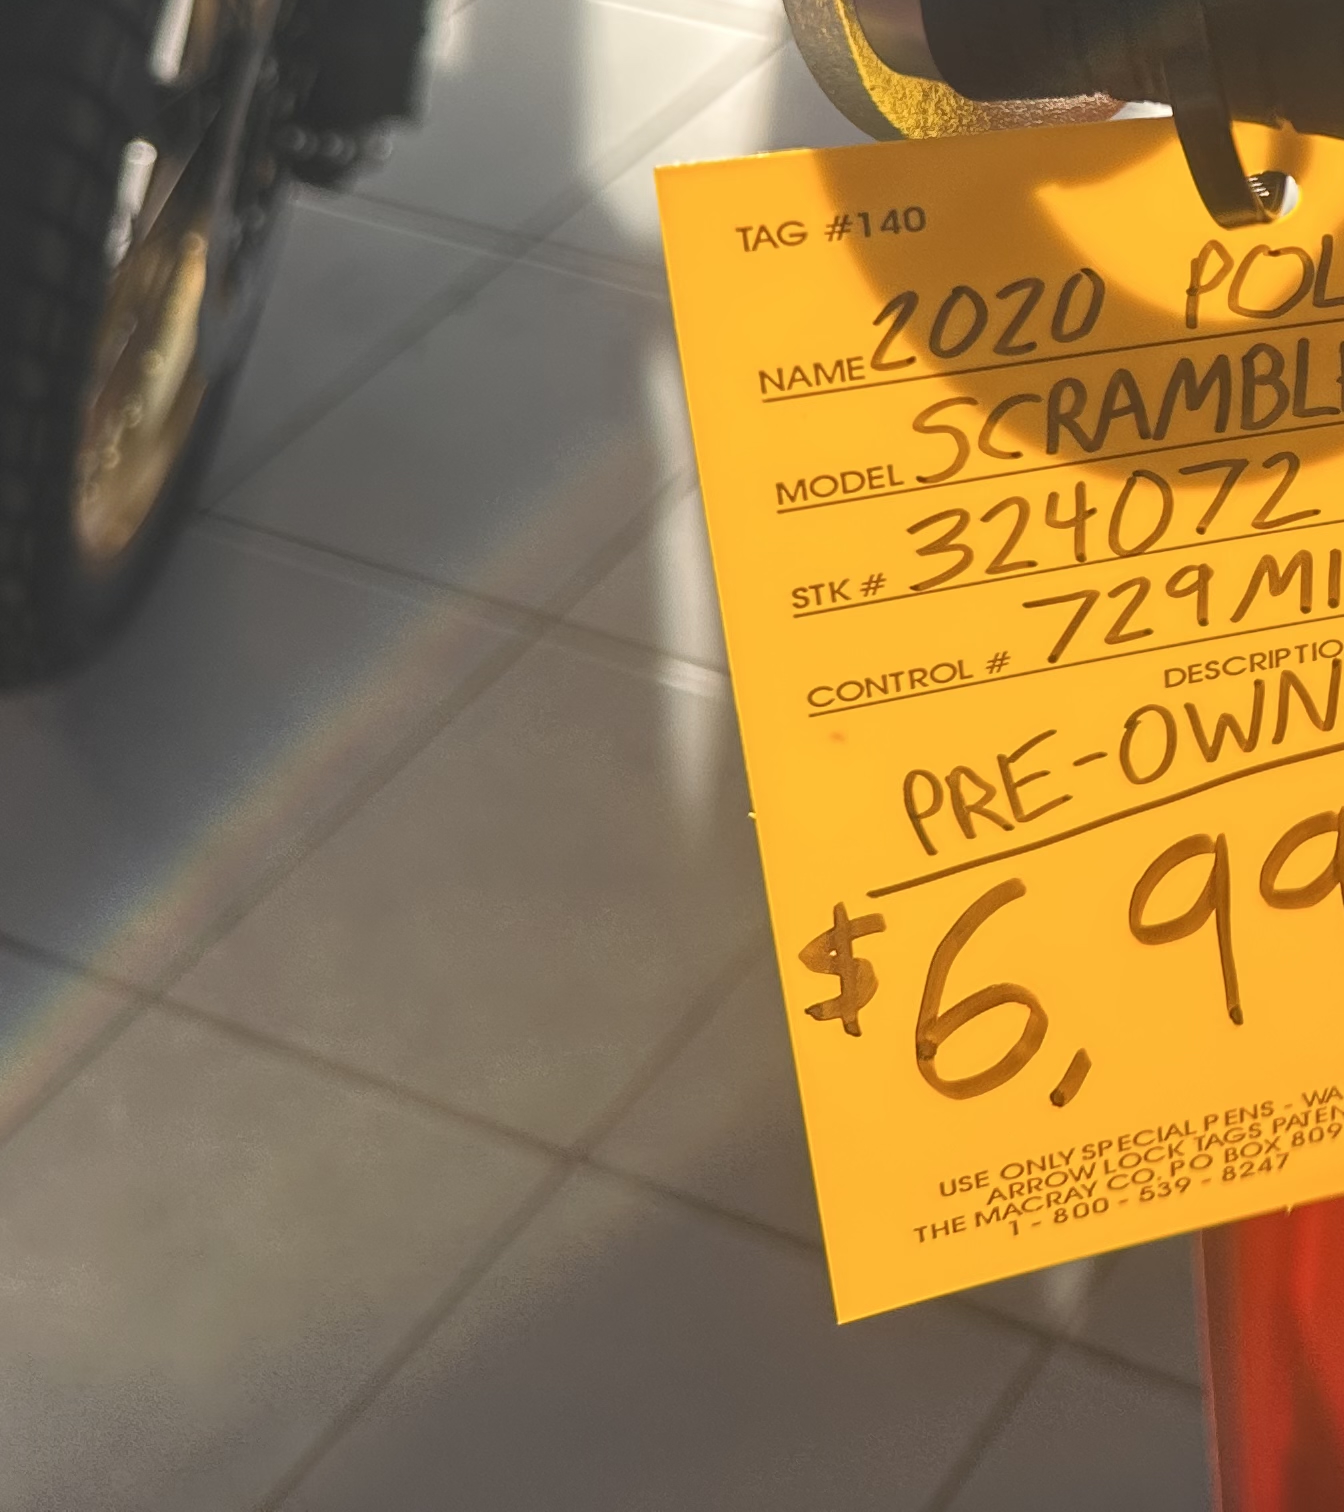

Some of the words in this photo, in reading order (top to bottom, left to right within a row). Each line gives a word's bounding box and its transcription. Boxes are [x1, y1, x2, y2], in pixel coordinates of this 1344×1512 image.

[735, 220, 808, 252] TAG
[825, 206, 927, 242] #140
[870, 267, 1105, 371] 2020
[758, 356, 866, 394] NAME
[776, 464, 904, 505] MODEL
[906, 451, 1321, 590] 324072
[791, 580, 852, 609] STK
[1022, 563, 1214, 664] 729
[806, 659, 974, 708] CONTROL
[913, 1215, 967, 1243] THE
[975, 1181, 1099, 1228] MACRAY
[1170, 1153, 1213, 1177] PO
[1223, 1135, 1281, 1163] BOX
[1290, 1122, 1342, 1148] 809
[939, 1170, 989, 1197] USE
[1000, 1147, 1076, 1182] ONLY
[1081, 1120, 1198, 1161] SPECIAL
[1202, 1100, 1275, 1131] PENS
[986, 1162, 1097, 1206] ARROW
[1103, 1140, 1185, 1175] LOCK
[1193, 1123, 1262, 1153] TAGS
[1053, 1197, 1110, 1224] 800
[1139, 1176, 1192, 1203] 539
[1221, 1152, 1291, 1183] 8247
